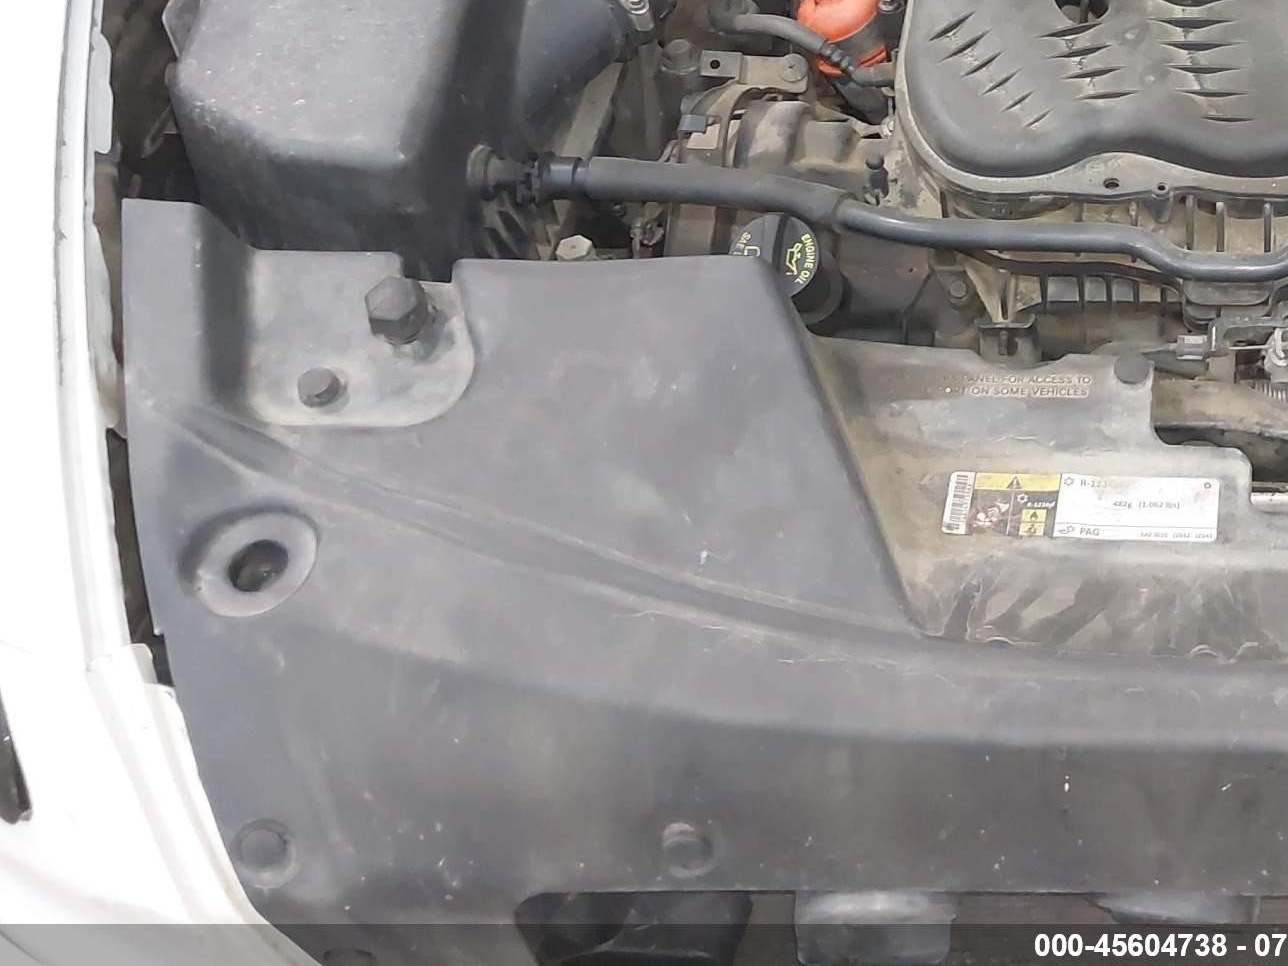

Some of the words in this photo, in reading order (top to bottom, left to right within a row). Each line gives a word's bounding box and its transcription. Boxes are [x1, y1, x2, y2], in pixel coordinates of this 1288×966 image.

[801, 233, 815, 269] ENGINE
[794, 270, 809, 284] OIL
[1028, 375, 1073, 385] ACCESS
[1077, 375, 1091, 385] TO
[971, 386, 989, 396] ON
[993, 386, 1028, 396] SOME
[1031, 387, 1088, 397] VEHICLES
[1079, 527, 1101, 537] PAG
